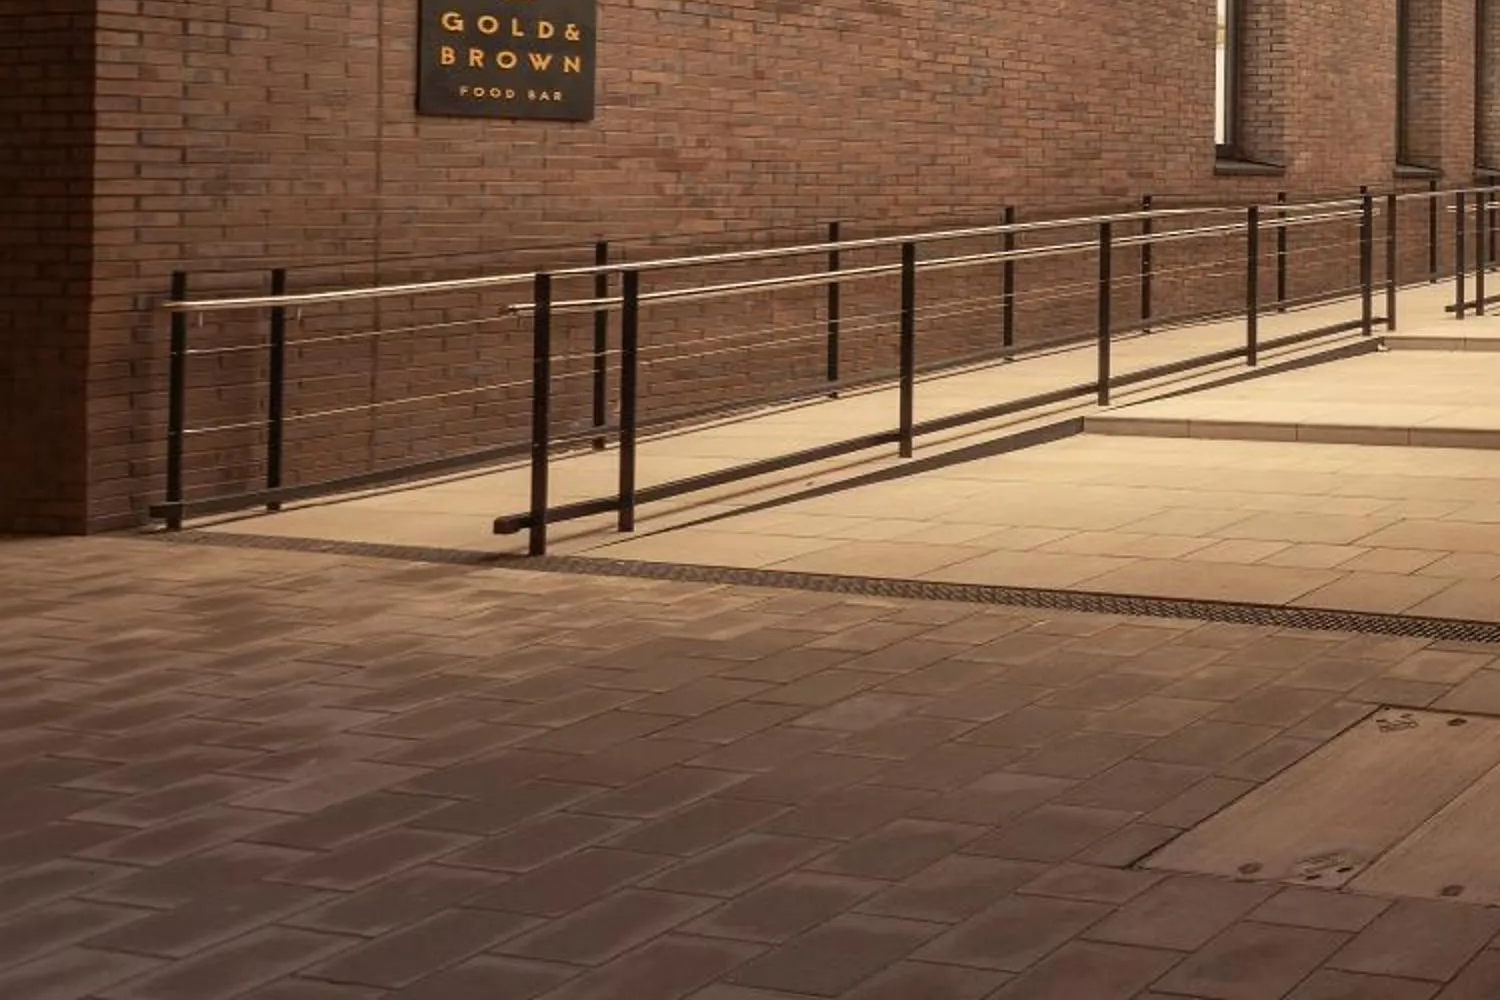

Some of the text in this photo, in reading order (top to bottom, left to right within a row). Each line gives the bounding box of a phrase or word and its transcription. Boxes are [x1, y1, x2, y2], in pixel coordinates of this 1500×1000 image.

[441, 11, 581, 41] GOLD&
[440, 46, 582, 73] BROWN
[459, 86, 563, 101] FOOD BAR
